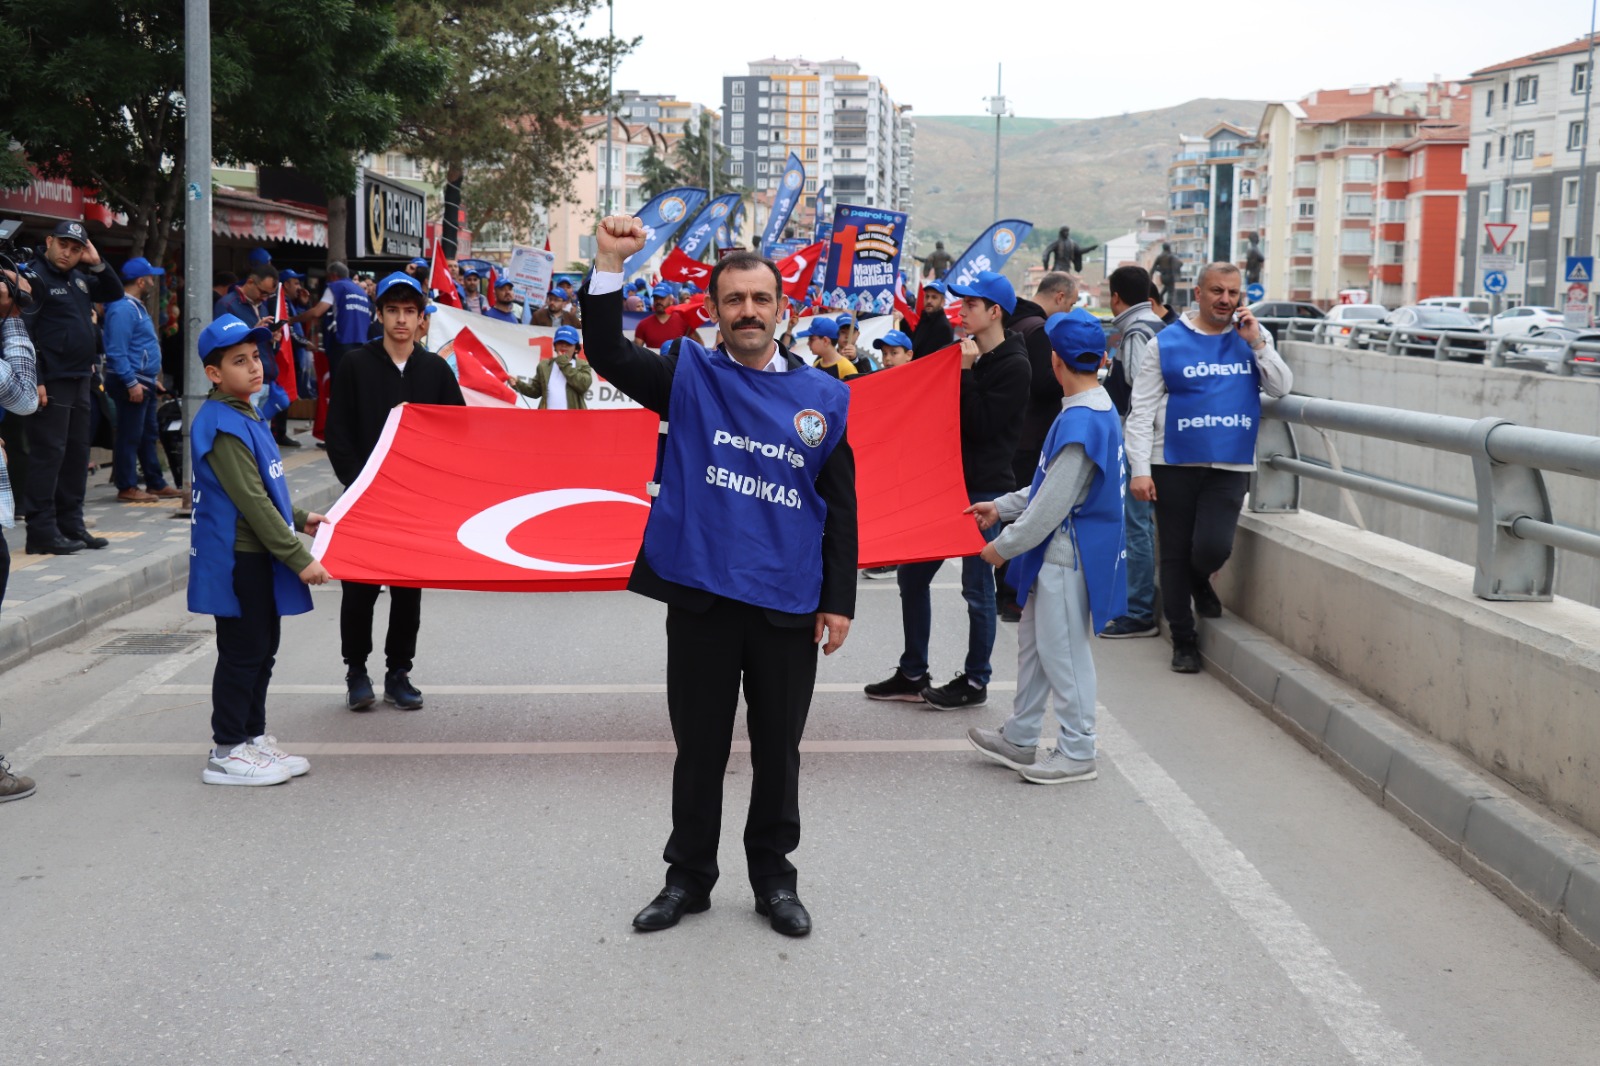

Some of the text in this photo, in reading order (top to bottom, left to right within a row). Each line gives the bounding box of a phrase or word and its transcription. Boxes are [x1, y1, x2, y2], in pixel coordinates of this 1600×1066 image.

[34, 179, 73, 204] yumurta
[386, 191, 423, 238] REYHAN
[850, 209, 893, 223] petrol-iş
[833, 224, 858, 288] 1
[853, 273, 894, 288] Alanlara
[1182, 359, 1252, 378] GÖREVLİ
[600, 386, 633, 402] DA
[1177, 413, 1252, 432] petrol-iş
[713, 429, 805, 469] petrol-iş
